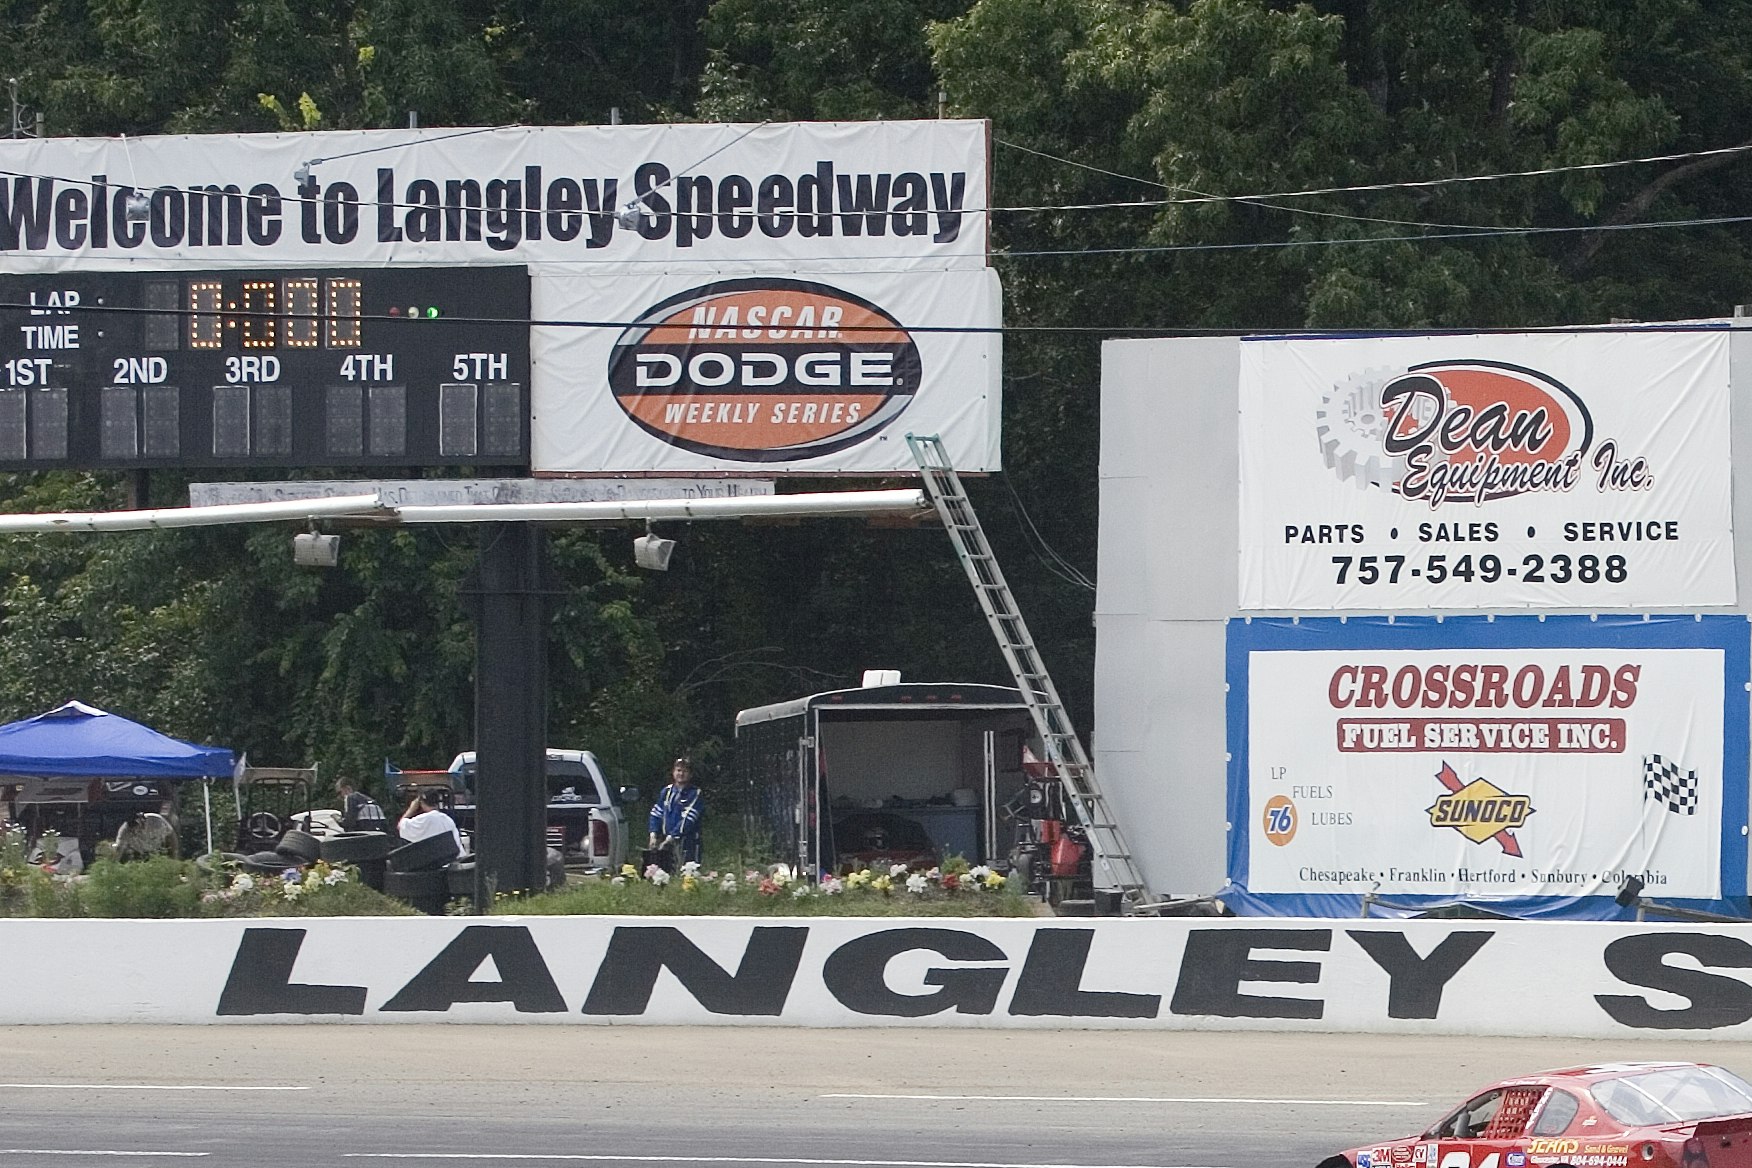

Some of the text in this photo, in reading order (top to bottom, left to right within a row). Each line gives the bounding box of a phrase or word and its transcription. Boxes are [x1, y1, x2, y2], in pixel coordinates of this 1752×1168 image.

[0, 160, 967, 253] Welcome to Langley Speedway
[30, 290, 80, 316] LAP
[21, 325, 80, 349] TIME
[688, 306, 844, 339] NASCAR
[5, 354, 508, 386] 1ST 2ND 3RD 4TH 5TH
[636, 352, 894, 386] DODGE
[664, 403, 862, 424] WEEKLY SERIES
[1379, 374, 1554, 457] Dean
[1400, 439, 1655, 510] Equipment Inc.
[1284, 521, 1679, 545] PARTS SALES SERVICE
[1332, 555, 1628, 586] 757-549-2388
[1327, 663, 1641, 709] CROSSROADS
[1342, 721, 1618, 750] FUEL SERVICE INC.
[1271, 766, 1287, 780] LP
[1292, 785, 1333, 800] FUELS
[1266, 804, 1292, 834] 76
[1311, 812, 1353, 826] LUBES
[1434, 797, 1527, 824] SUNOCO
[1299, 868, 1667, 887] Chesapeake Franklin Hertford Sunbury Colbia
[216, 925, 1495, 1022] LANGLEY
